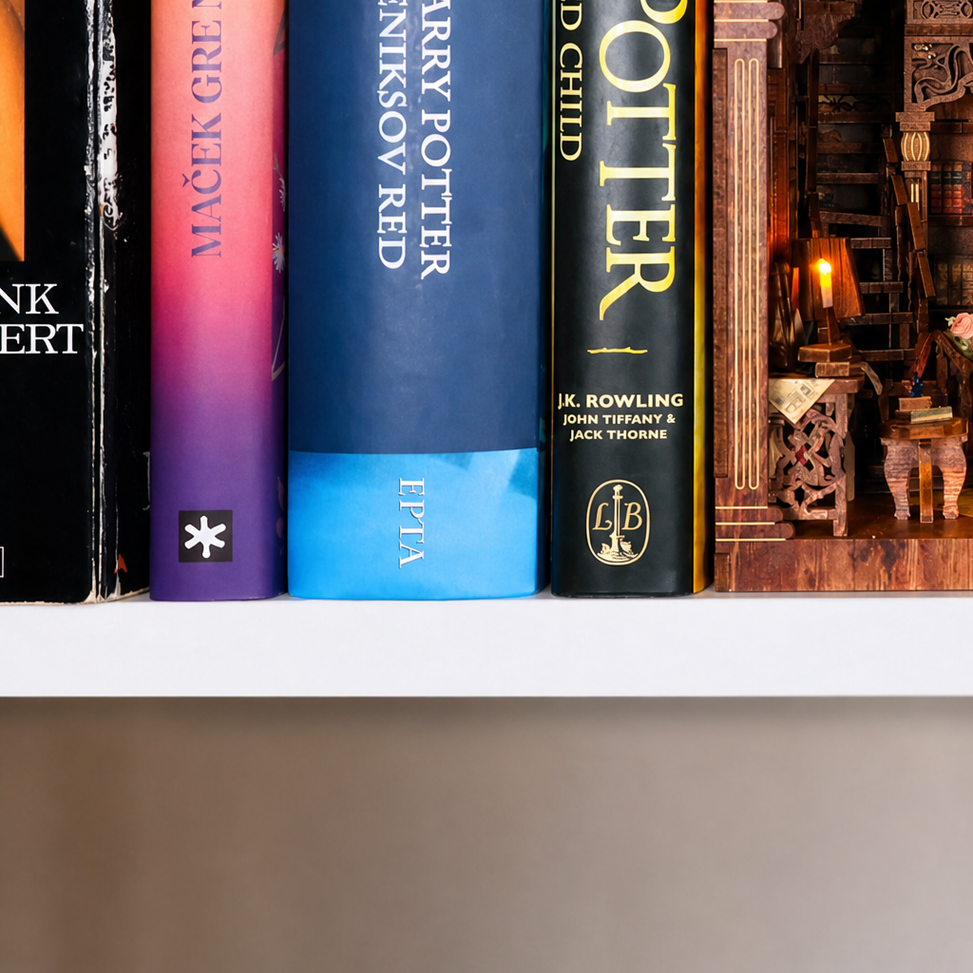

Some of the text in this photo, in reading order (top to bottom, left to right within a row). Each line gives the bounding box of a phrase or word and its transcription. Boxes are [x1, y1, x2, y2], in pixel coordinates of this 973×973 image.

[191, 20, 222, 104] GRE
[559, 42, 583, 161] CHILD
[182, 112, 222, 258] MAČEK
[377, 184, 407, 269] RED
[419, 109, 453, 280] POTTER
[0, 324, 84, 354] ERT
[558, 393, 683, 410] J.K. ROWLING
[563, 413, 676, 426] JOHN TIFFANY &
[569, 429, 668, 442] JACK THORNE
[399, 477, 425, 569] EPTA
